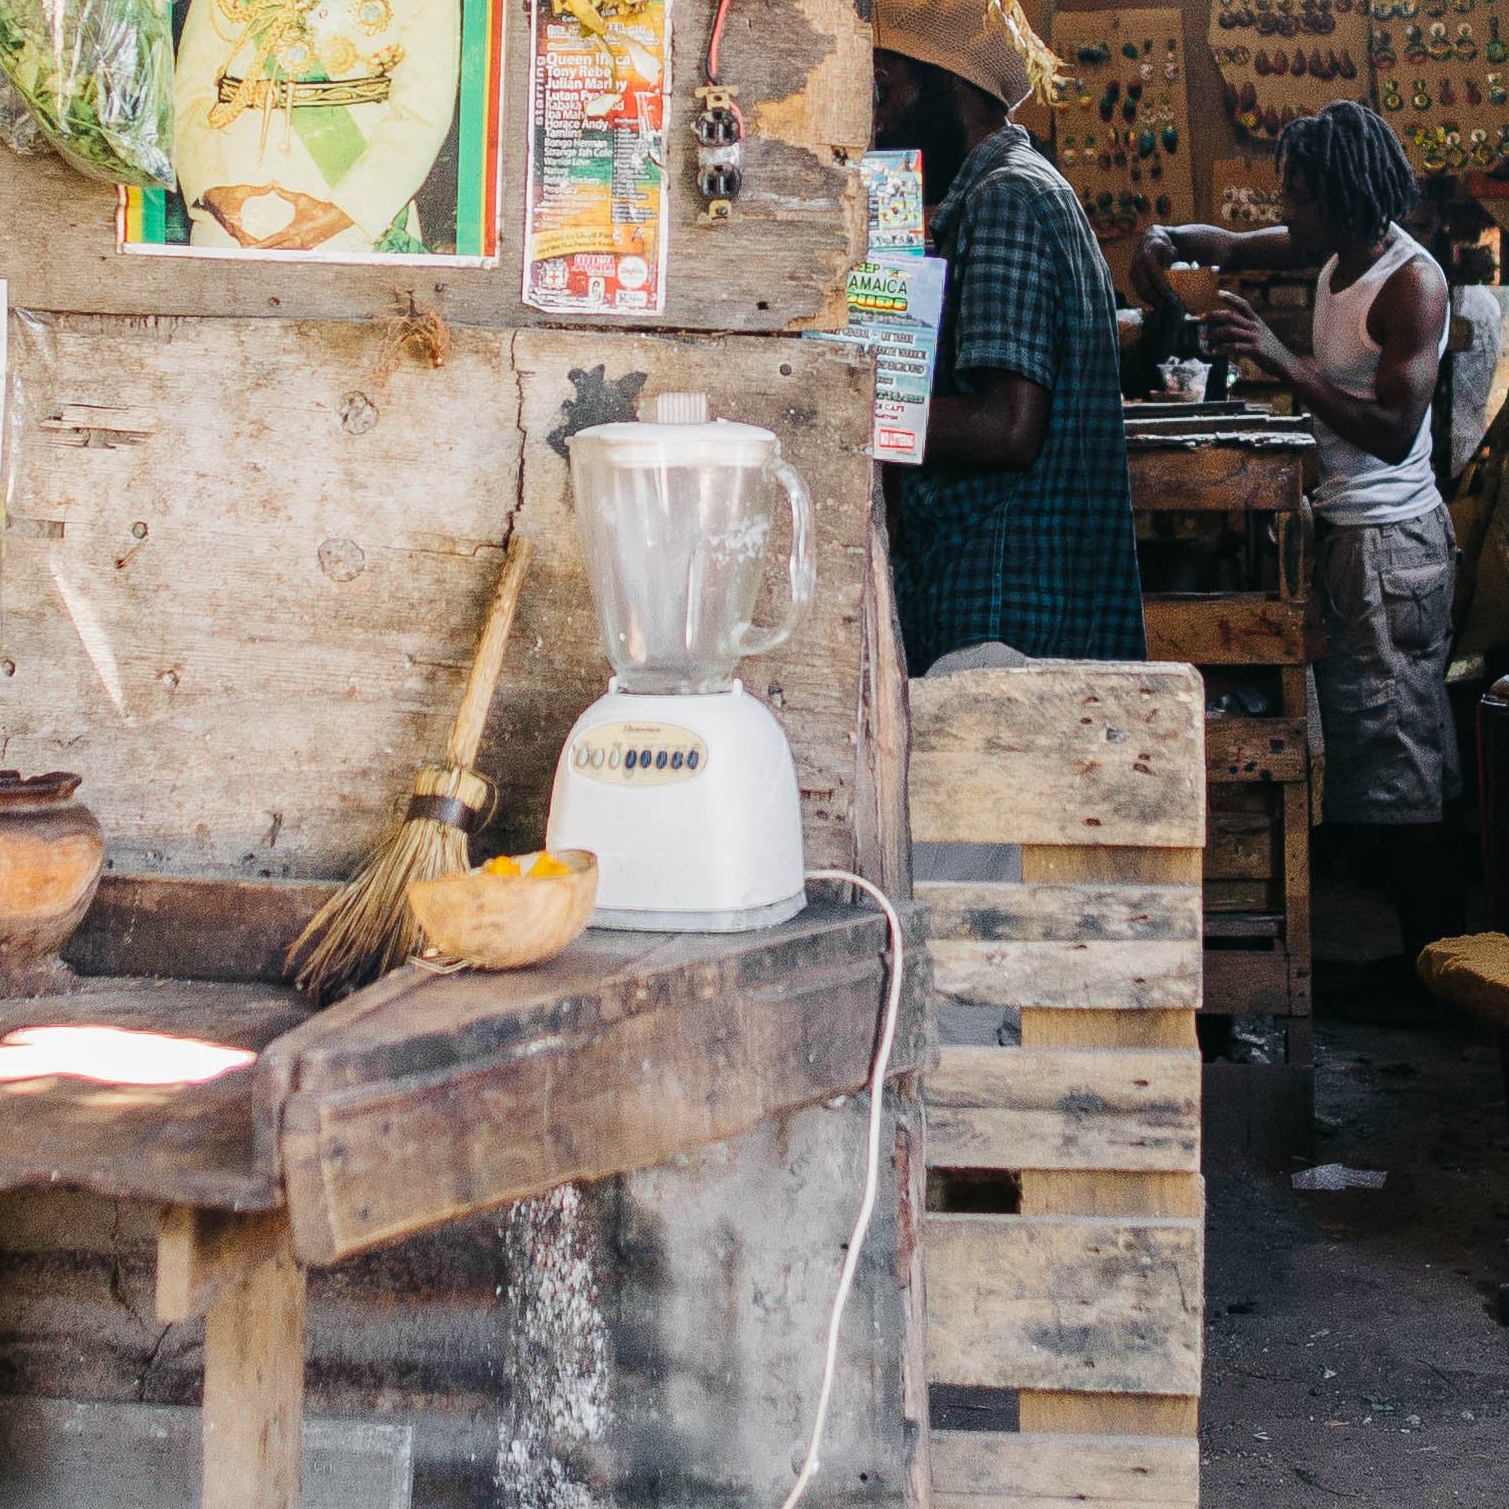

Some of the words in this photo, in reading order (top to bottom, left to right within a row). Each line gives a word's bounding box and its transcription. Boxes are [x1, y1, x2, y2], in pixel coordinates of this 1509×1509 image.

[547, 52, 592, 67] Queen
[546, 66, 578, 80] Tony
[579, 66, 612, 78] Rebe
[545, 77, 583, 90] Julian
[584, 77, 628, 93] Marly
[546, 90, 580, 101] Lutan
[581, 118, 610, 132] Andy
[858, 261, 881, 274] EEP
[848, 275, 908, 294] AMAICA
